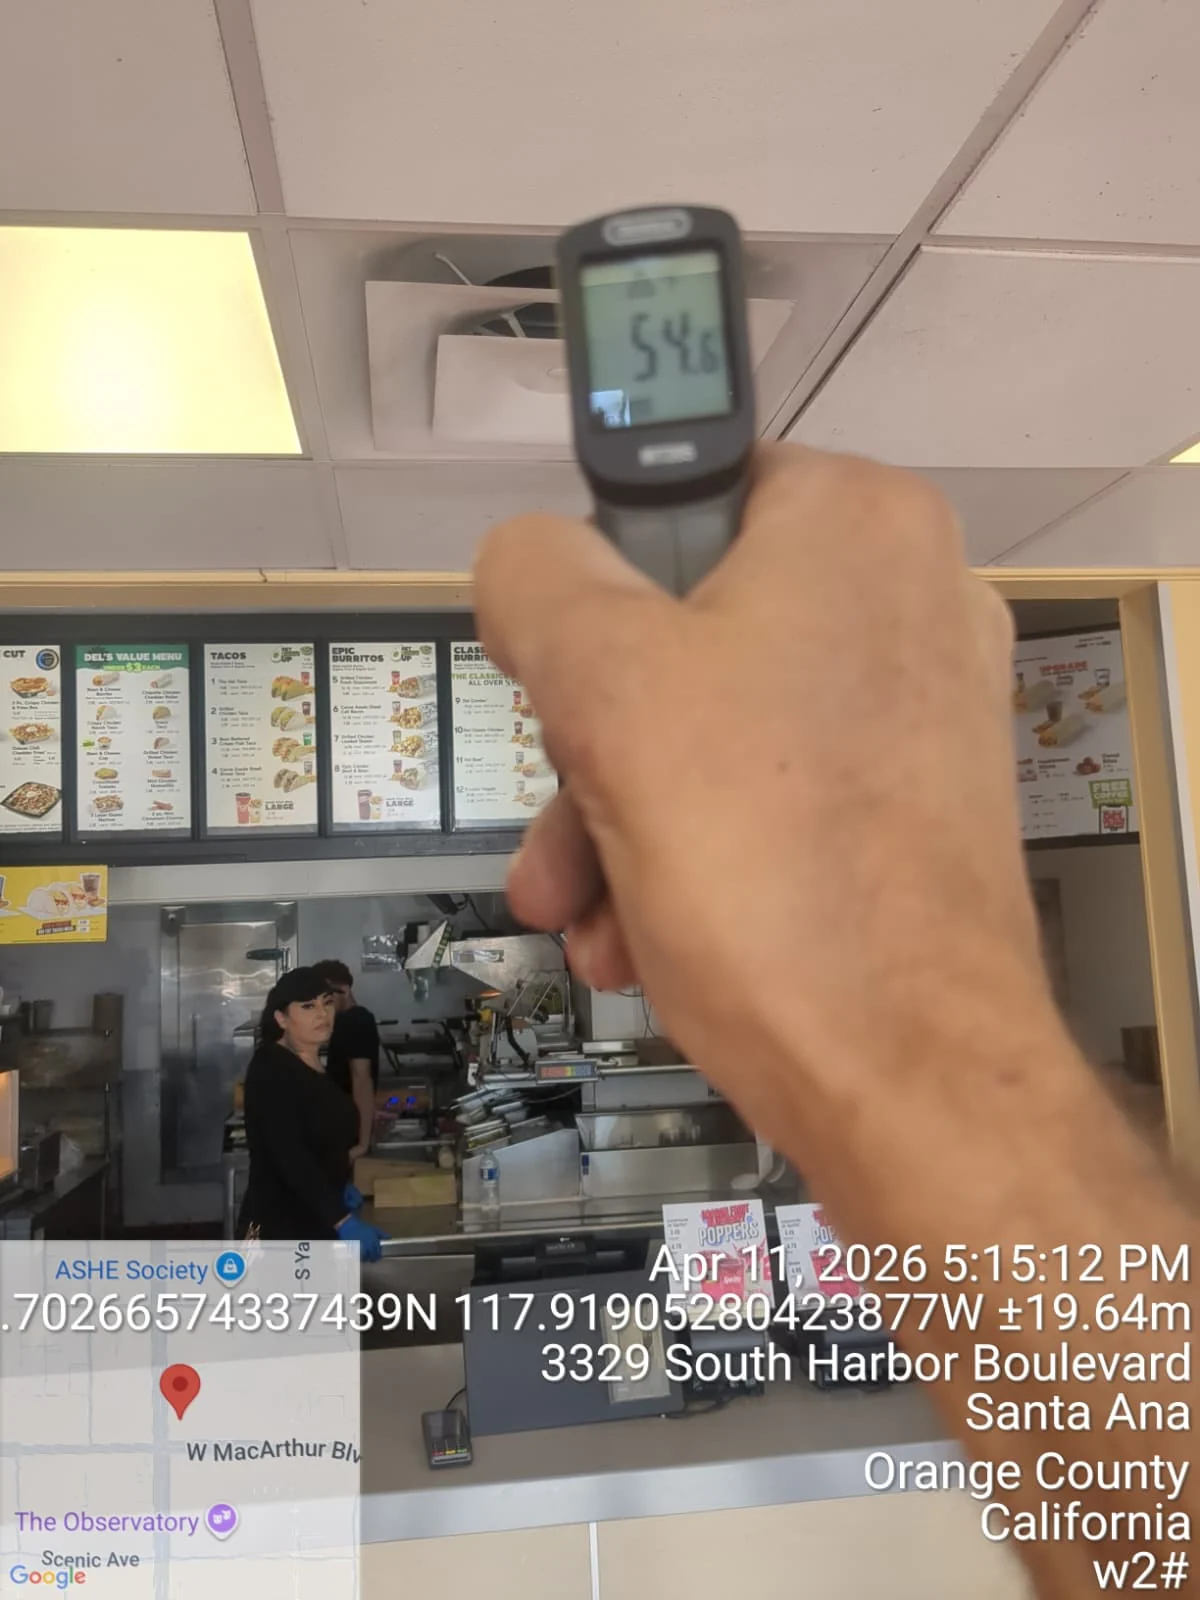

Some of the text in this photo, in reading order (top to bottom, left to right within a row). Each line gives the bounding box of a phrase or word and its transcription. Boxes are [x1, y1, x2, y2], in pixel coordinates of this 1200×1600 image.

[3, 650, 26, 658] CUT
[332, 647, 355, 655] EPIC
[84, 652, 182, 661] DEL'S VALUE MENU
[210, 652, 247, 660] TACOS
[332, 655, 384, 663] BURRITOS
[699, 1221, 759, 1247] POPPERS
